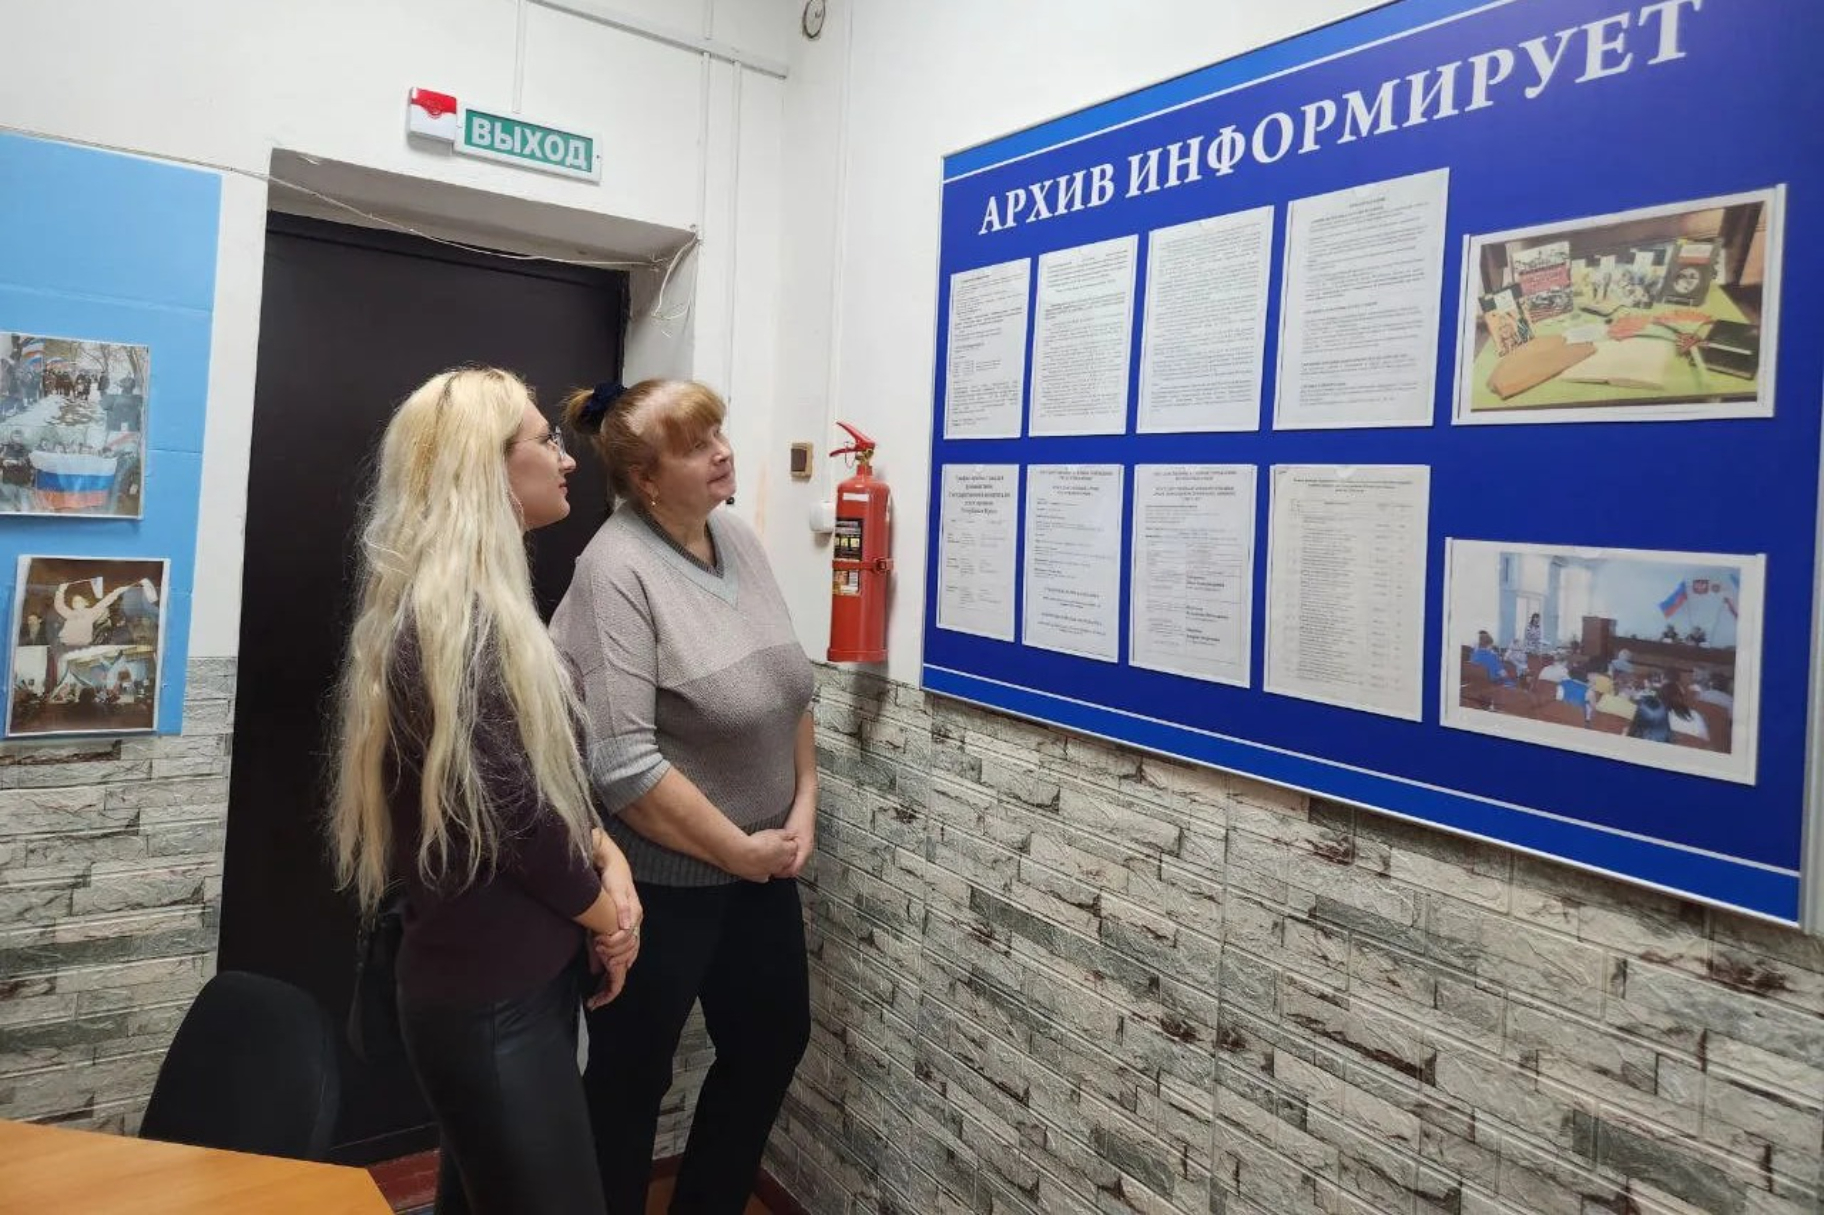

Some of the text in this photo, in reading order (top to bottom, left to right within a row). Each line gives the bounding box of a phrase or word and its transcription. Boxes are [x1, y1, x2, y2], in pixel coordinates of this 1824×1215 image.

[471, 116, 588, 170] ВЫХОД
[978, 0, 1702, 235] АРХИВ ИНФОРМИРУЕТ
